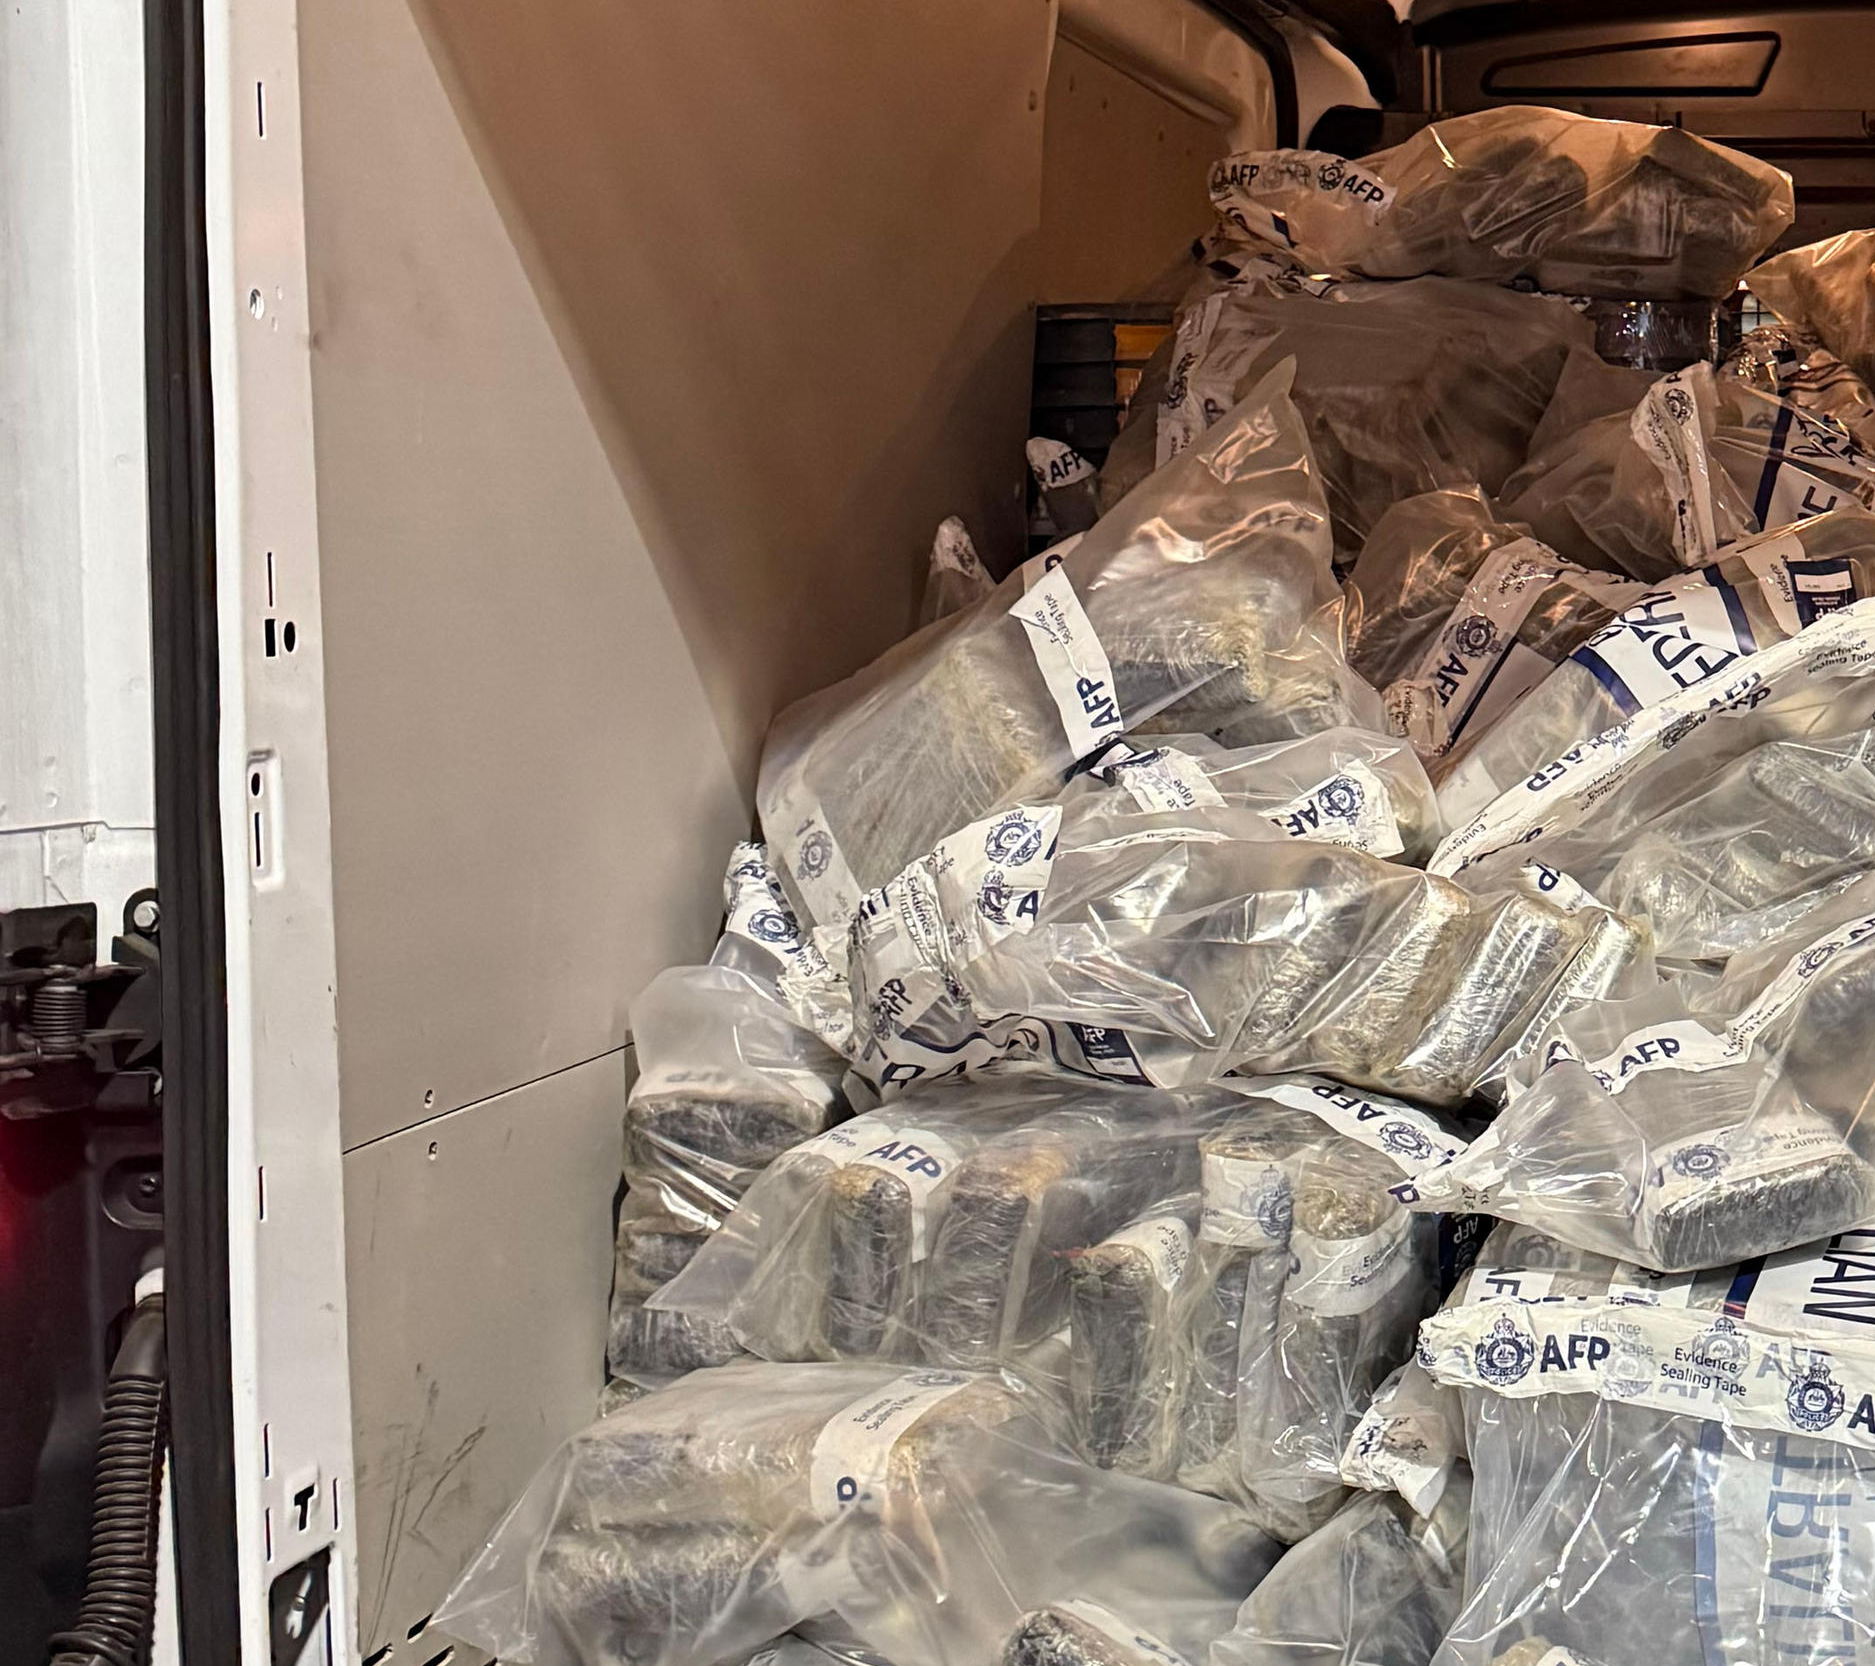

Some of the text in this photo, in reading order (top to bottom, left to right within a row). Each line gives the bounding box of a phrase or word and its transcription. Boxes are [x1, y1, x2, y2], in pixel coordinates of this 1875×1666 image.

[1230, 164, 1259, 186] AFP
[1343, 174, 1384, 203] AFP
[1436, 653, 1468, 708] AF
[1076, 676, 1122, 729] AFP
[1270, 799, 1320, 837] AF
[1620, 1037, 1681, 1076] AFP
[1312, 1085, 1387, 1121] AFP
[868, 1140, 942, 1178] AFP
[1540, 1333, 1610, 1373] AFP
[1674, 1346, 1738, 1374] Evidence
[1660, 1363, 1712, 1390] Sealing
[1711, 1374, 1747, 1397] Tape
